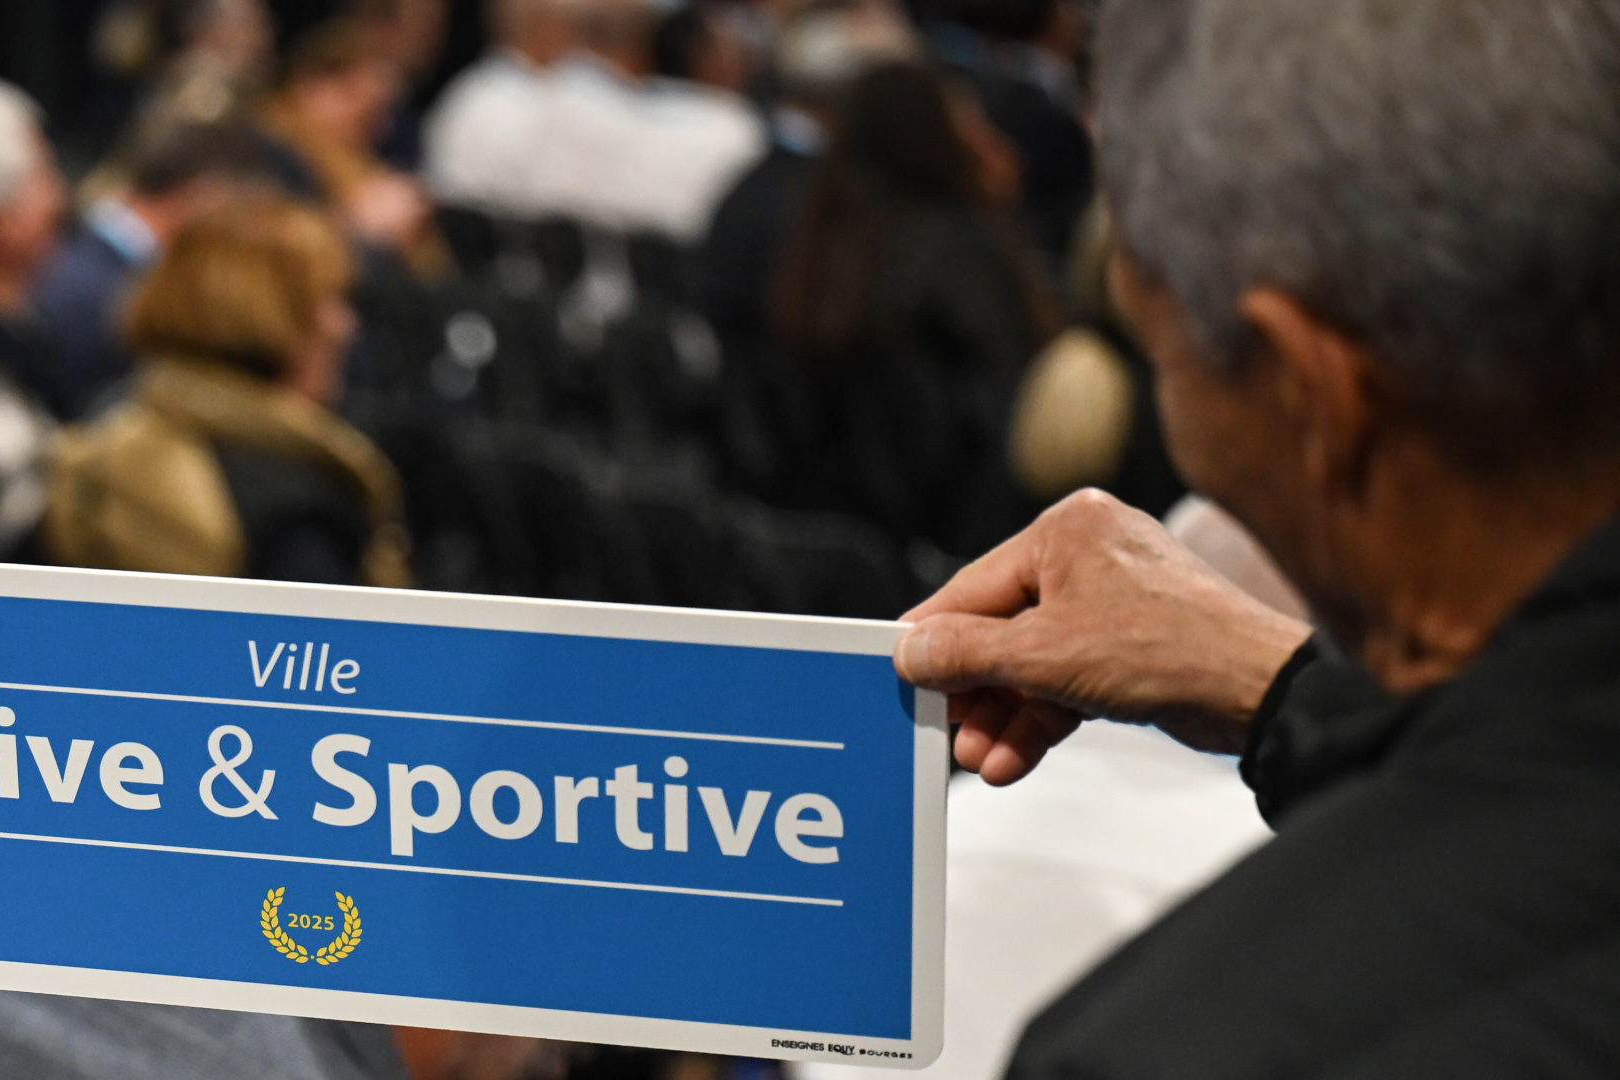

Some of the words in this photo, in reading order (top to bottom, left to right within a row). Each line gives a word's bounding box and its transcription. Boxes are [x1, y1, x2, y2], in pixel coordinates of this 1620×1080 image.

[247, 640, 361, 695] Ville
[198, 724, 279, 820] &
[311, 733, 844, 864] Sportive
[287, 912, 335, 931] 2025
[770, 1038, 825, 1052] ENSEIGNES
